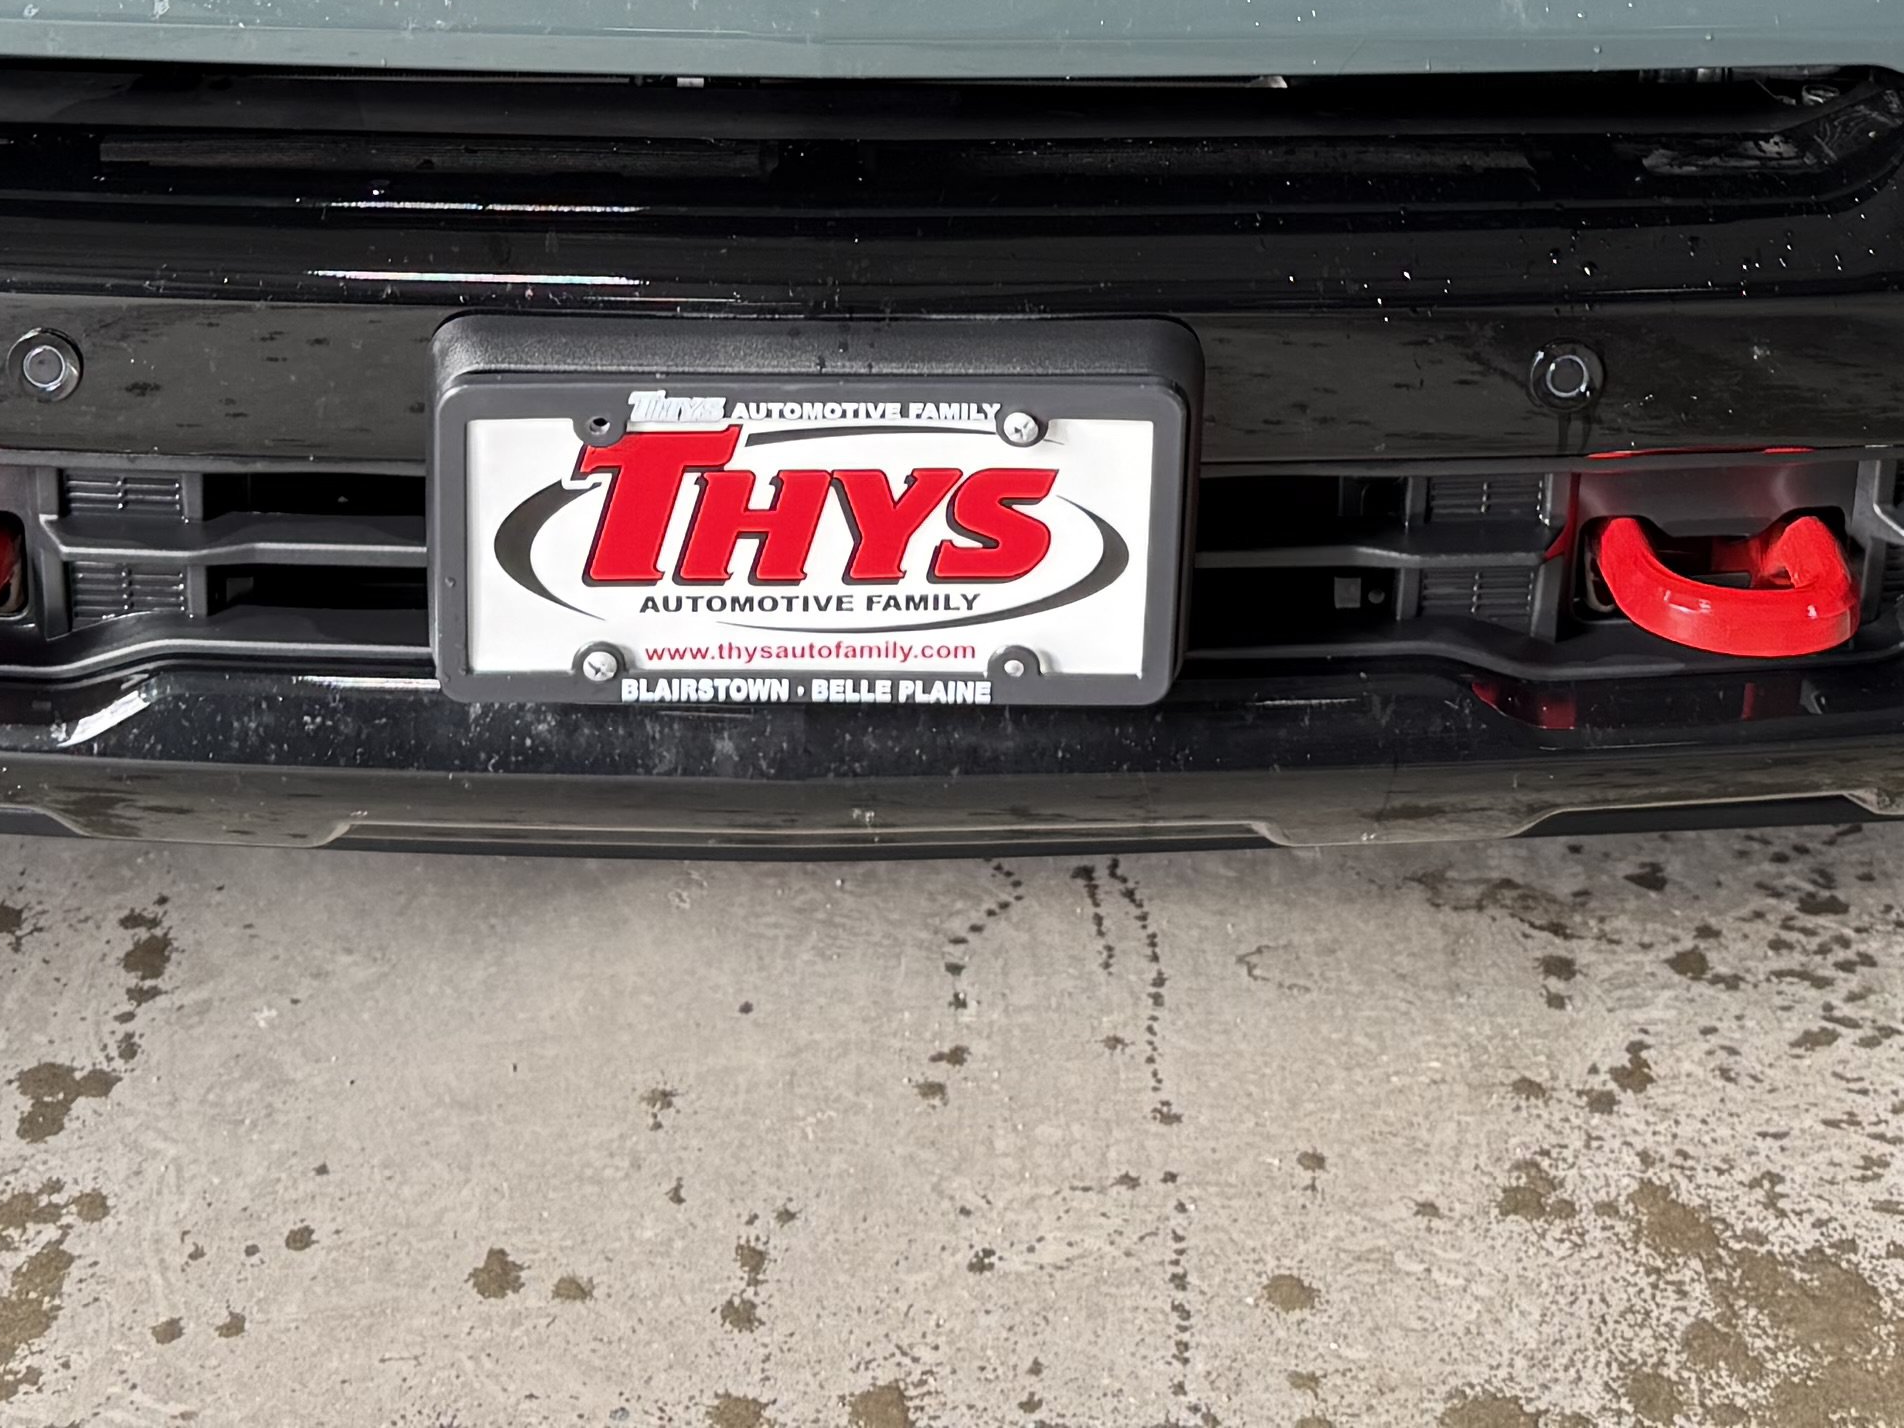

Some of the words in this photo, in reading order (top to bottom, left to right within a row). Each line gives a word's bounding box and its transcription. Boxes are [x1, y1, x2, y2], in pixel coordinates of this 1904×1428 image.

[731, 401, 901, 421] AUTOMOTIVE
[908, 402, 1001, 421] FAMILY
[578, 425, 1060, 586] THYS
[639, 594, 854, 613] AUTOMOTIVE
[865, 593, 981, 612] FAMILY
[645, 640, 977, 664] www.thysautofamily.com
[621, 677, 790, 704] BLAIRSTOWN
[811, 679, 892, 704] BELLE
[898, 679, 992, 705] PLAINE
